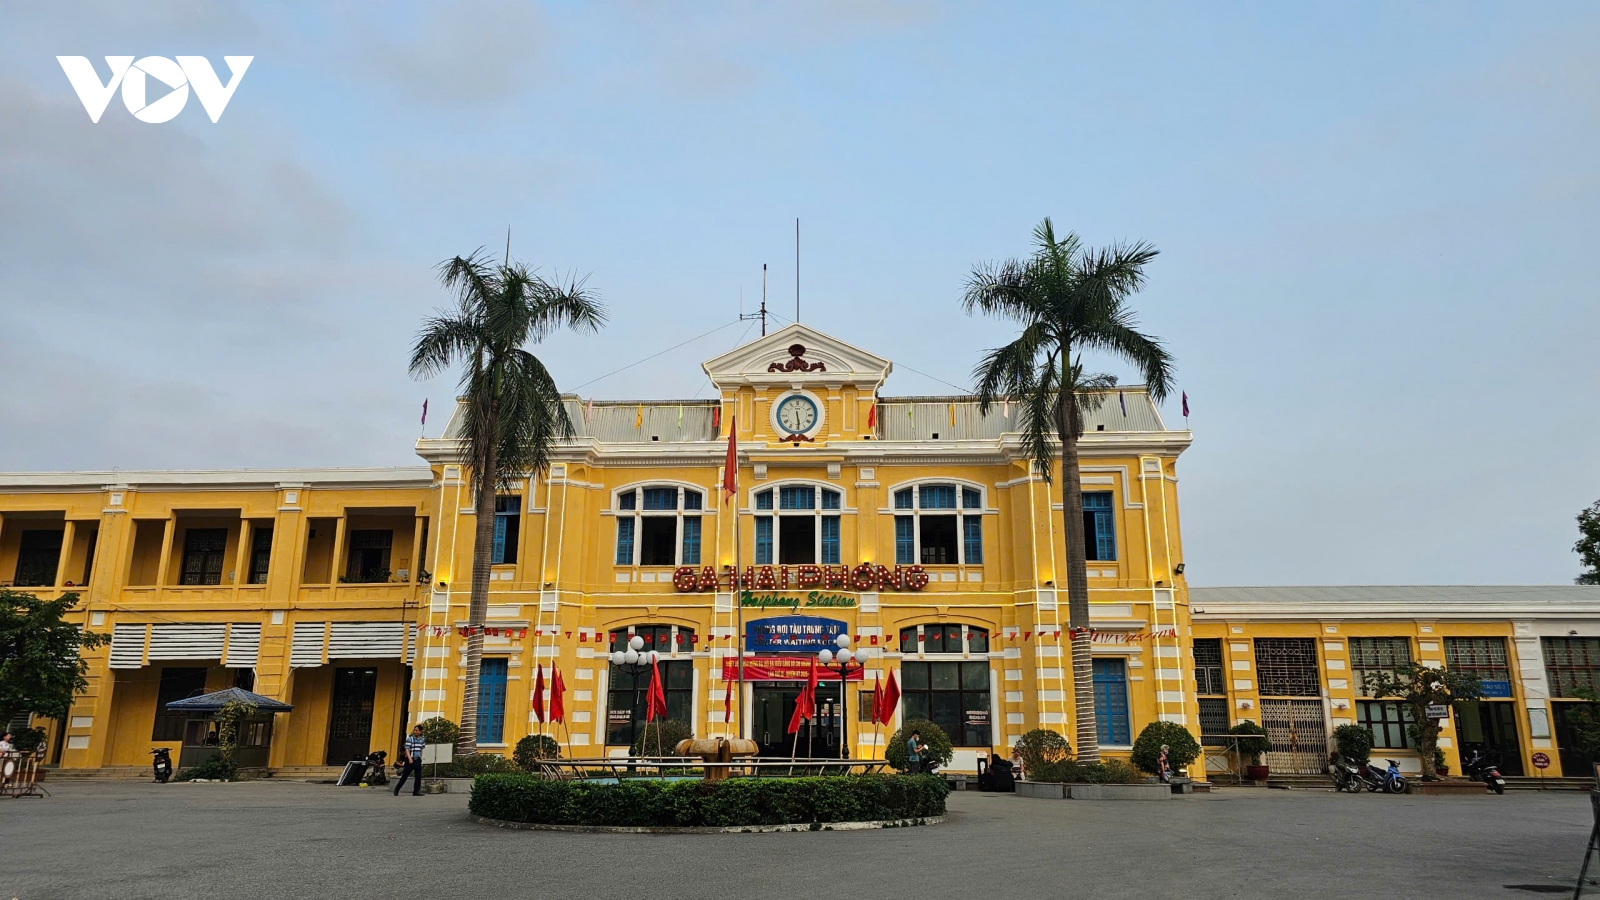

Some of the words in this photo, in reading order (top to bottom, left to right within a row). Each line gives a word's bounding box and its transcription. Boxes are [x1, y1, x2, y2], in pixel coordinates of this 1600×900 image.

[673, 566, 720, 592] GA
[729, 566, 788, 590] HAI
[798, 565, 929, 591] PHONG
[805, 591, 856, 607] Station
[789, 622, 802, 635] TÀU
[803, 624, 824, 635] TRUNG
